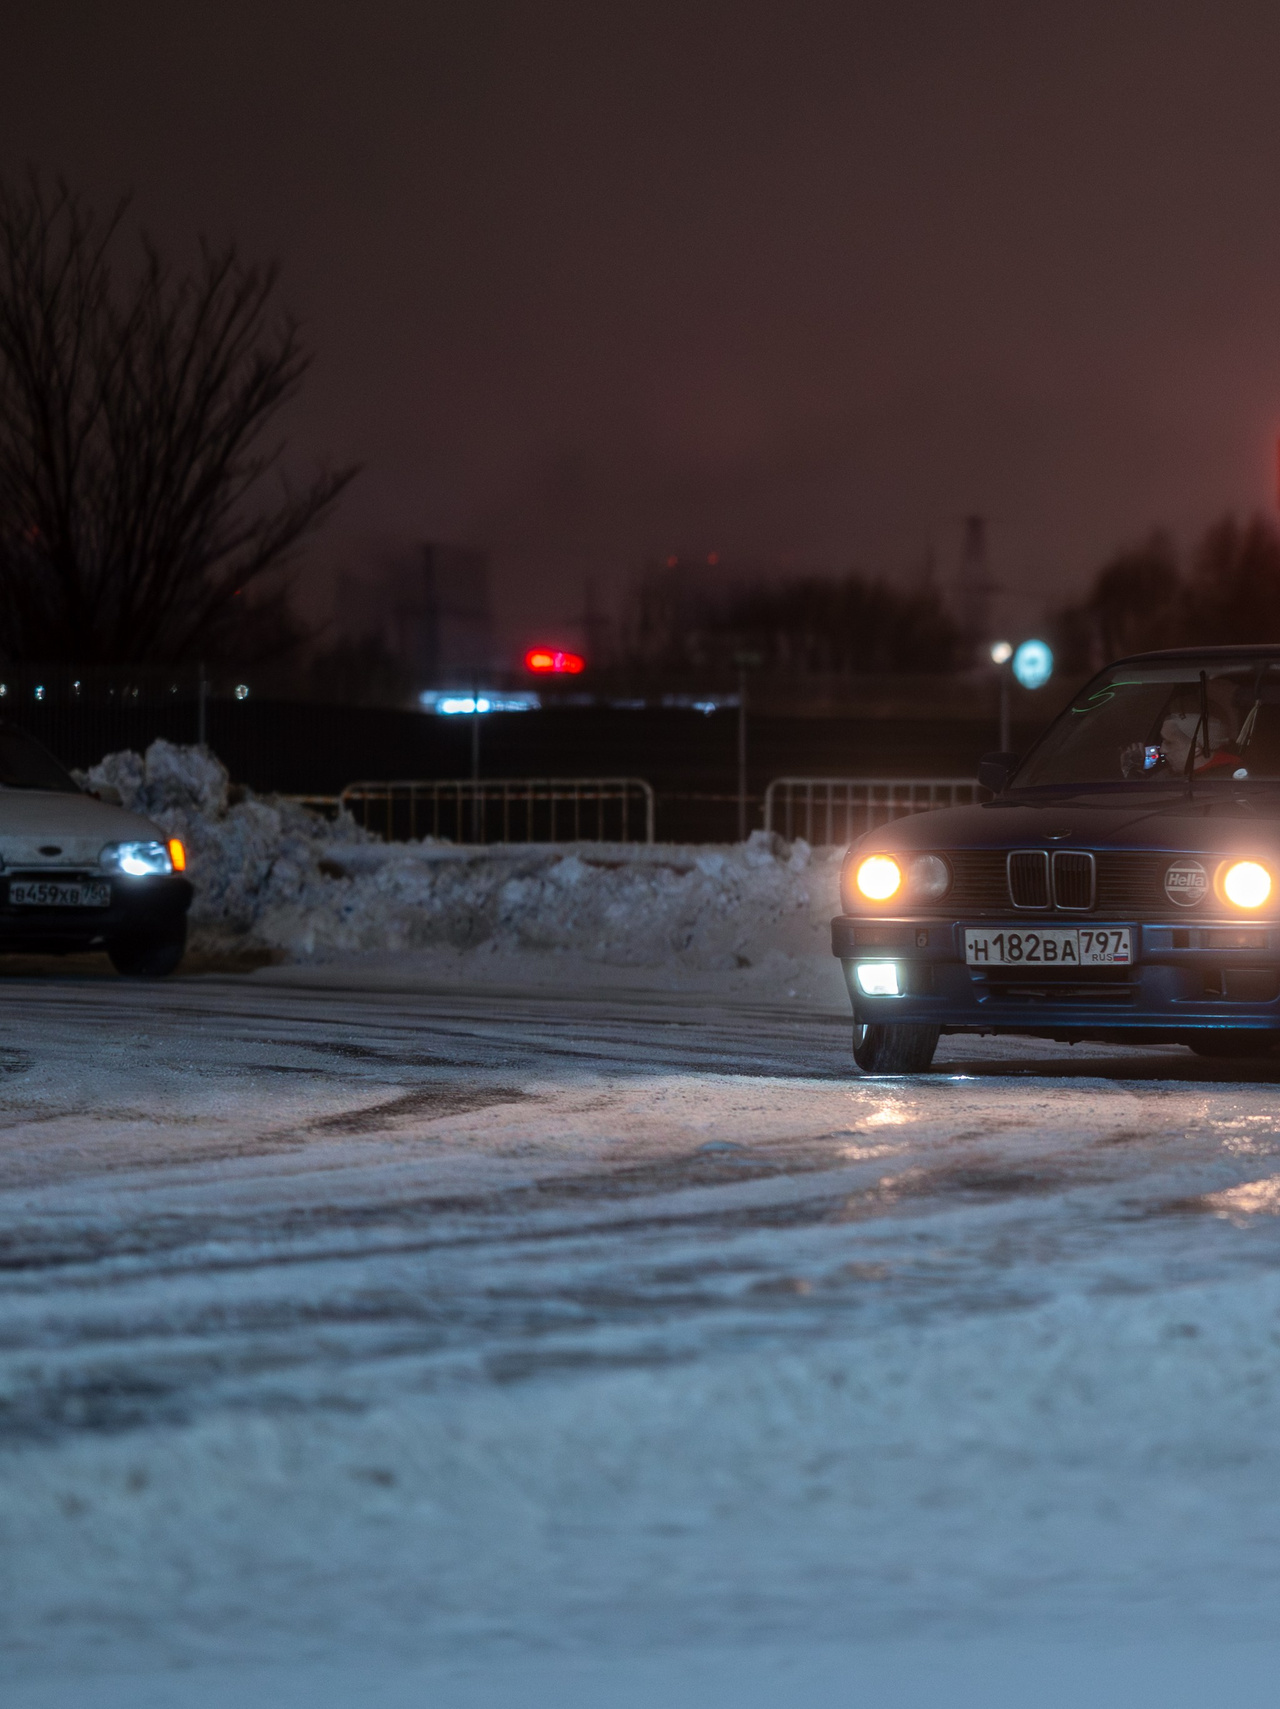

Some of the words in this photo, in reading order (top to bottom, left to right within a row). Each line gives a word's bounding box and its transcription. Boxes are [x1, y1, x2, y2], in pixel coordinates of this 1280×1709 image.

[1168, 873, 1205, 886] Hella
[974, 933, 1077, 962] Н182ВА
[1081, 931, 1123, 954] 797
[1092, 953, 1112, 962] RUS
